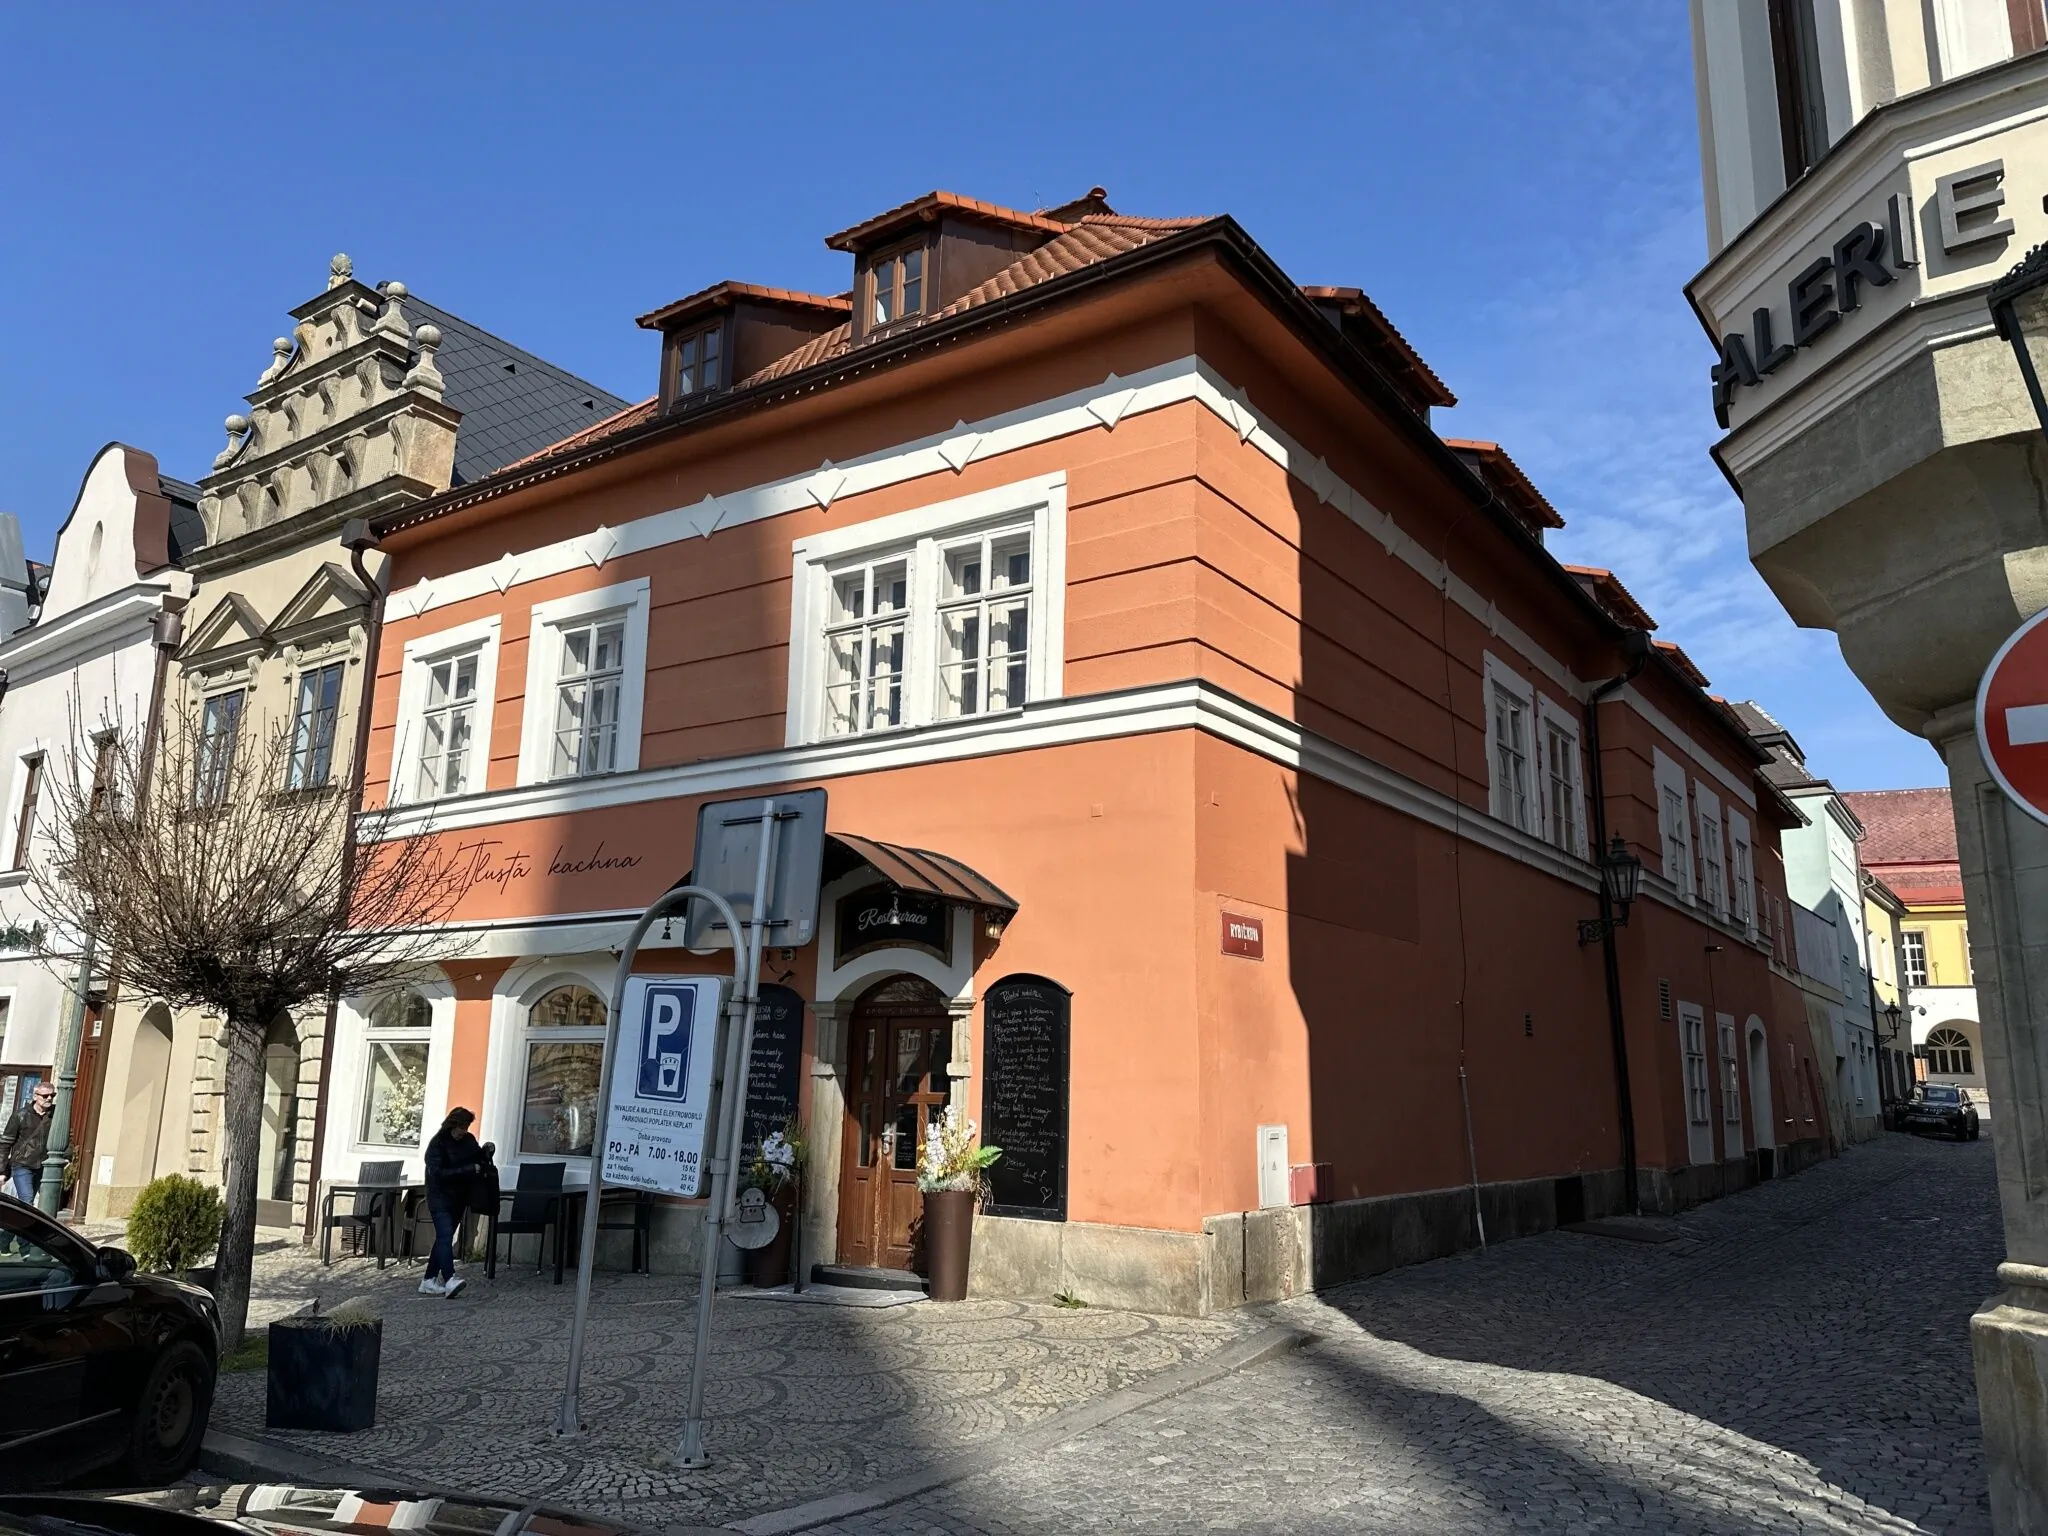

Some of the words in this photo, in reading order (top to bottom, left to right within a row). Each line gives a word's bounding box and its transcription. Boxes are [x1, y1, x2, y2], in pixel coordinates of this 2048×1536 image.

[458, 841, 531, 900] Tlustá
[548, 841, 643, 877] kachna
[648, 994, 681, 1060] P
[649, 1118, 672, 1127] POPLATEK
[638, 1132, 650, 1140] Doba
[651, 1136, 672, 1144] provozu
[609, 1142, 621, 1153] PO
[629, 1142, 639, 1156] PÁ
[648, 1147, 666, 1159] 7.00
[674, 1150, 698, 1164] 18.00
[689, 1165, 696, 1173] Kč
[612, 1172, 629, 1180] každou
[687, 1184, 694, 1192] Kč
